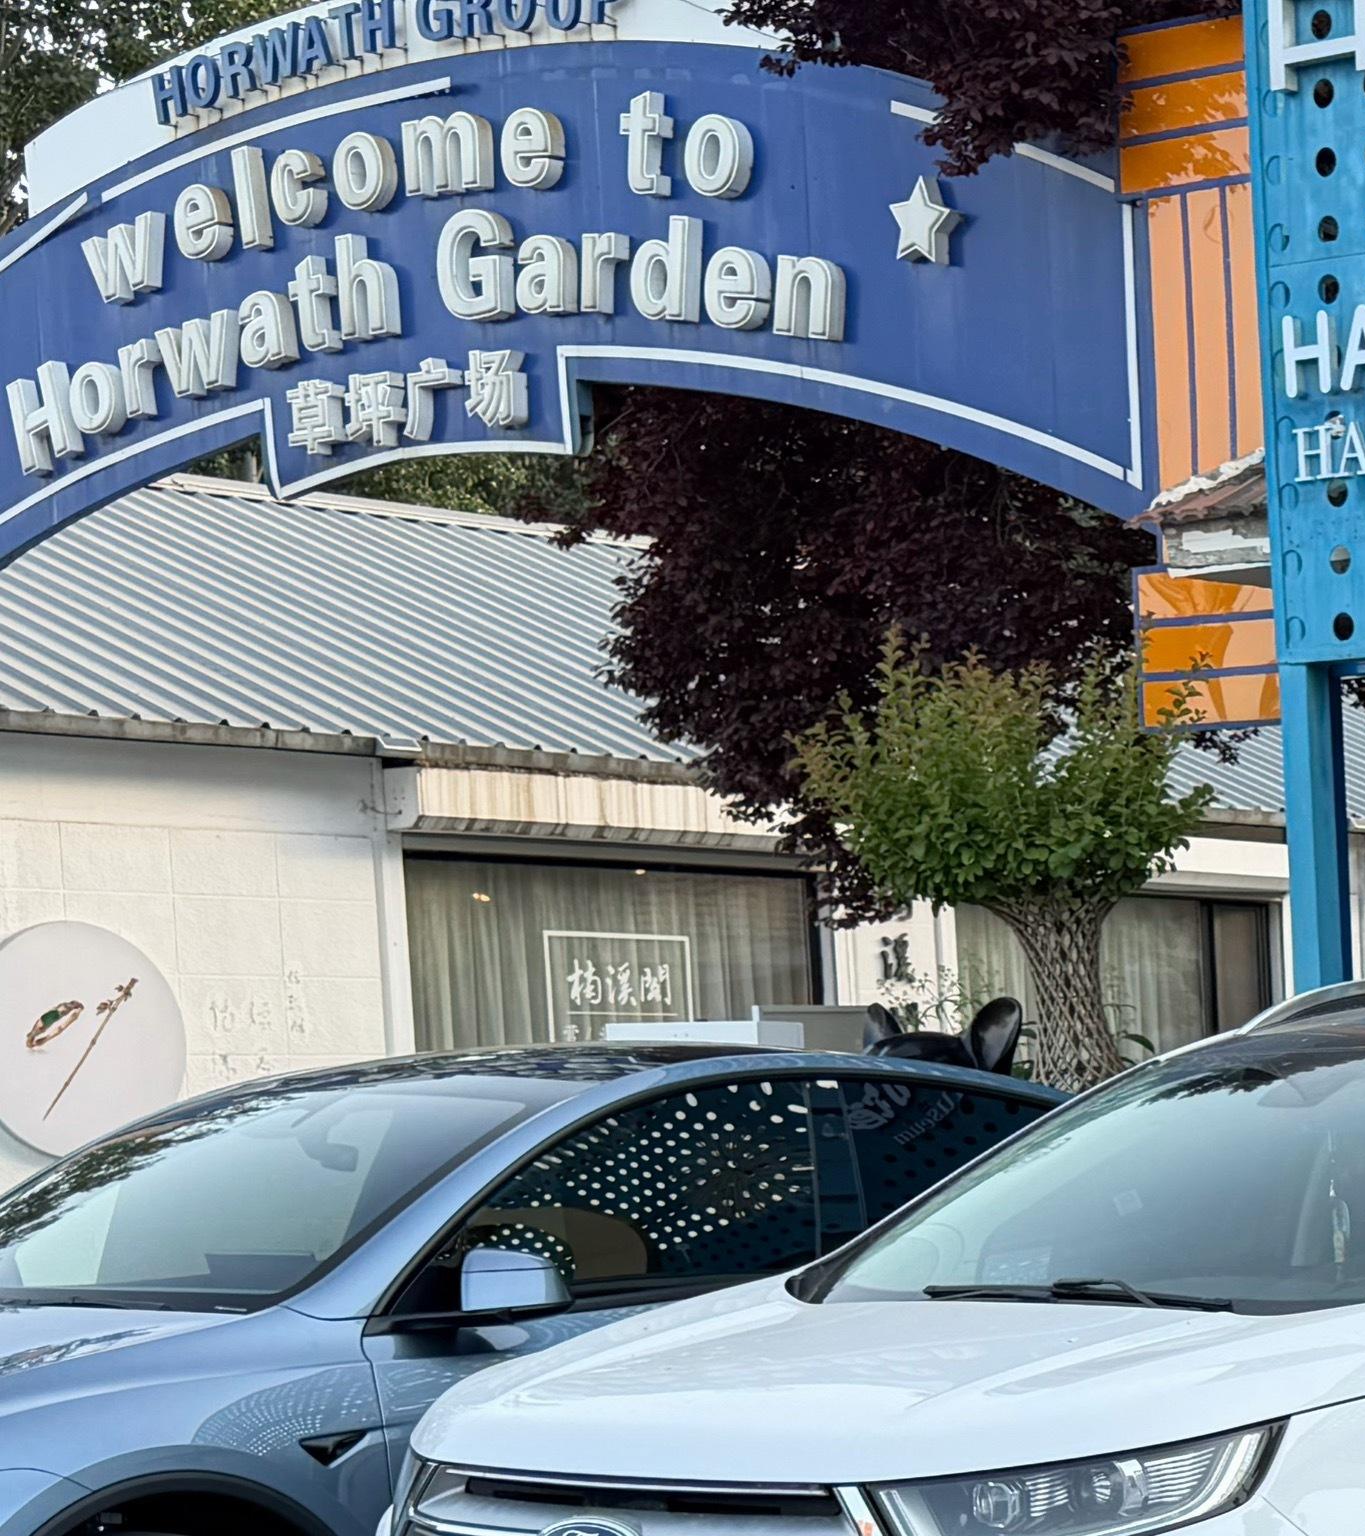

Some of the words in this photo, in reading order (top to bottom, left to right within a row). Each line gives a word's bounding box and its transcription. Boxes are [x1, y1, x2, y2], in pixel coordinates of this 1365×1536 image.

[152, 0, 397, 126] HORWATH
[619, 89, 755, 199] to
[5, 232, 402, 476] Horwath
[436, 208, 847, 341] Garden
[286, 350, 527, 456] 草坪广场
